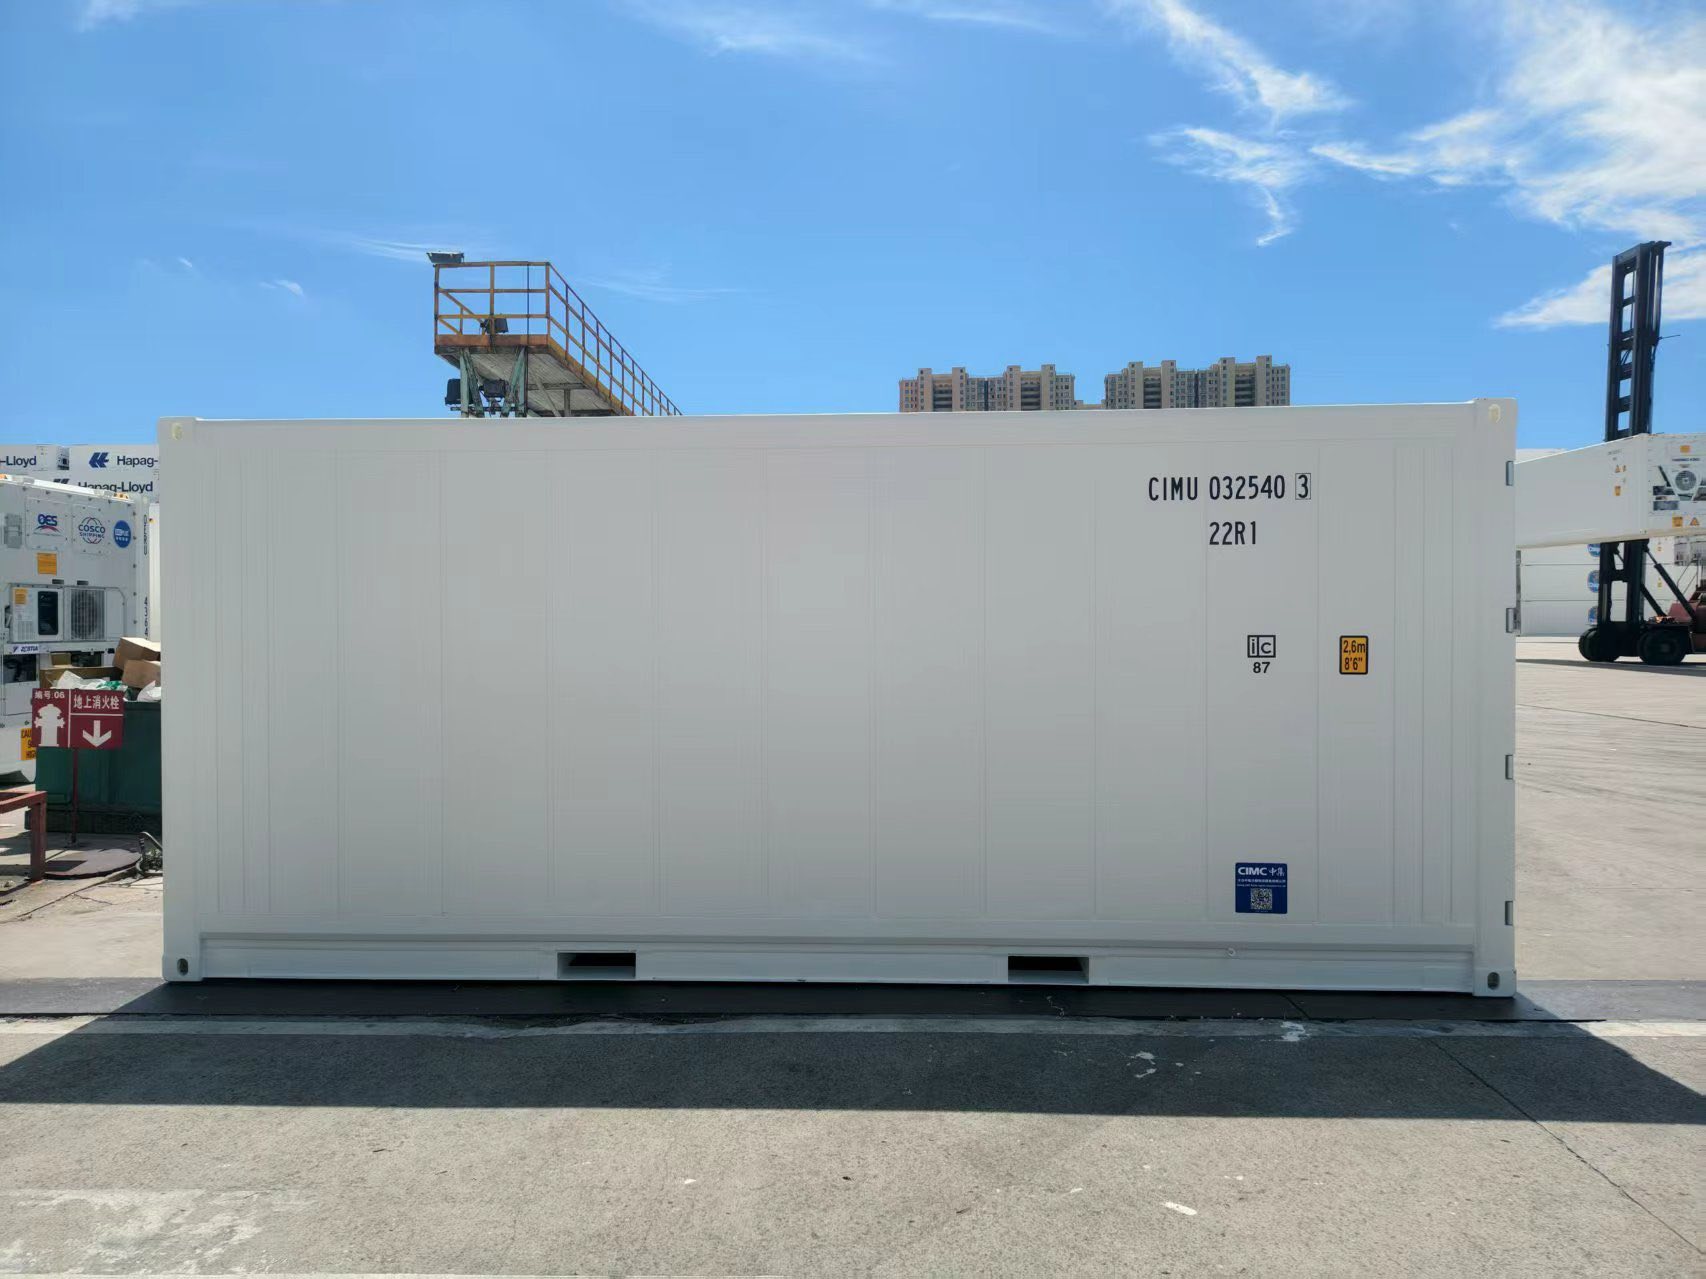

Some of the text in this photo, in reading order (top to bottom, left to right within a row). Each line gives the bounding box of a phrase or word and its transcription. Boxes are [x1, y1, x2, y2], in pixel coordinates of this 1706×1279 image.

[1148, 474, 1310, 501] CIMU 032540 3
[78, 524, 106, 534] COSCO
[1209, 521, 1257, 546] 22R1
[1253, 662, 1271, 674] 87
[73, 694, 120, 710] 地上消火栓
[1238, 866, 1268, 876] CIMC
